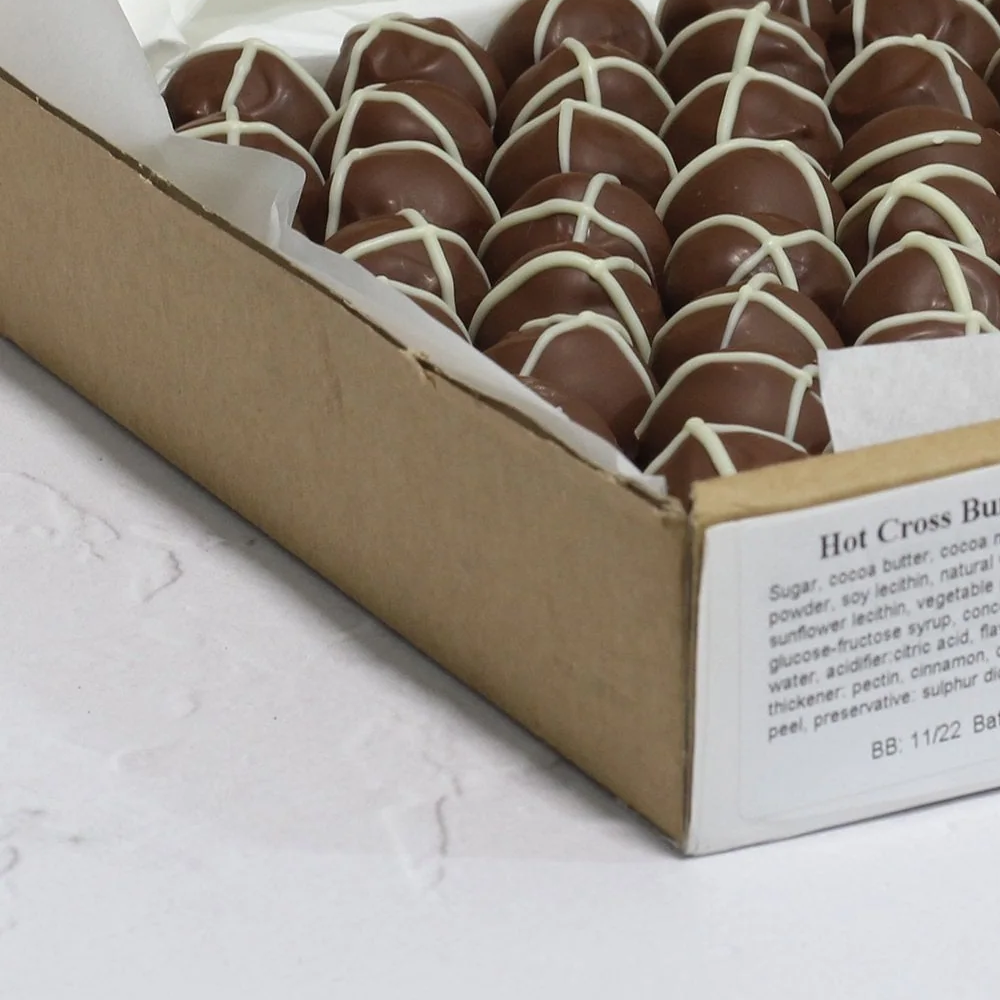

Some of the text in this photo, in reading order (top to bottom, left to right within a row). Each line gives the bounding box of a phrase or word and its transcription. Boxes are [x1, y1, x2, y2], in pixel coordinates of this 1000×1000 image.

[820, 529, 867, 560] Hot
[877, 511, 951, 543] Cross
[768, 578, 822, 602] Sugar,
[829, 564, 877, 586] cocoa
[882, 550, 933, 573] butter,
[940, 536, 987, 558] cocoa
[769, 599, 835, 628] powder,
[842, 589, 870, 607] soy
[875, 572, 934, 599] lecithin,
[940, 556, 993, 582] natural
[769, 616, 846, 649] sunflower
[851, 601, 910, 627] lecithin,
[916, 580, 993, 610] vegetable
[769, 626, 902, 675] glucose-fructose
[907, 613, 956, 637] syrup,
[910, 650, 989, 680] cinnamon,
[813, 690, 916, 731] preservative:
[922, 672, 978, 700] sulphur
[871, 736, 903, 760] BB:
[911, 719, 962, 749] 11/22
